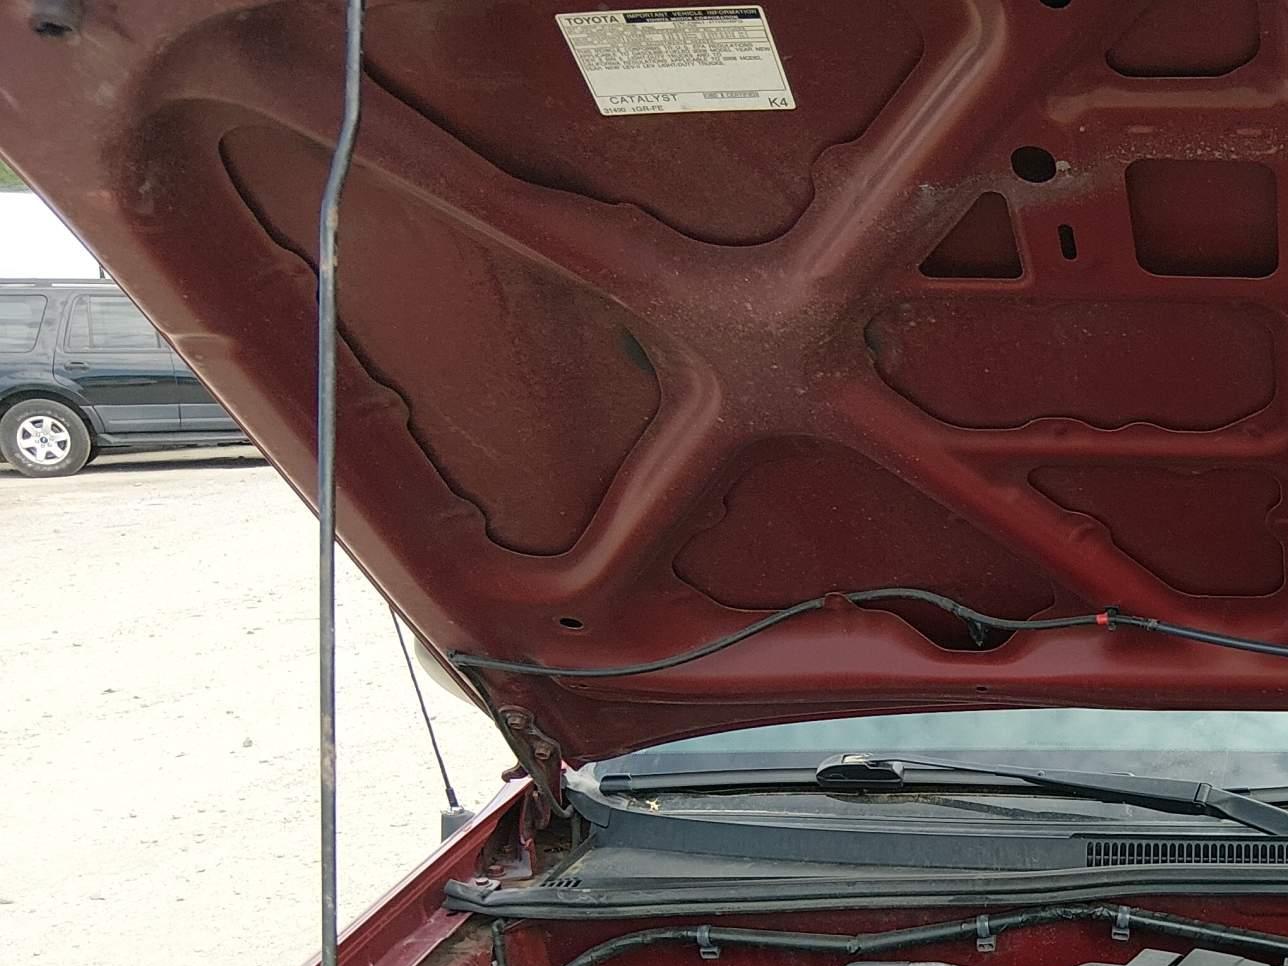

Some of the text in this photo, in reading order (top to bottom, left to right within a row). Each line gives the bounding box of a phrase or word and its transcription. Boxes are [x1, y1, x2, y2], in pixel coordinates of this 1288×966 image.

[565, 16, 619, 25] TOYOTA
[609, 93, 679, 105] CATALYST
[768, 98, 789, 108] K4
